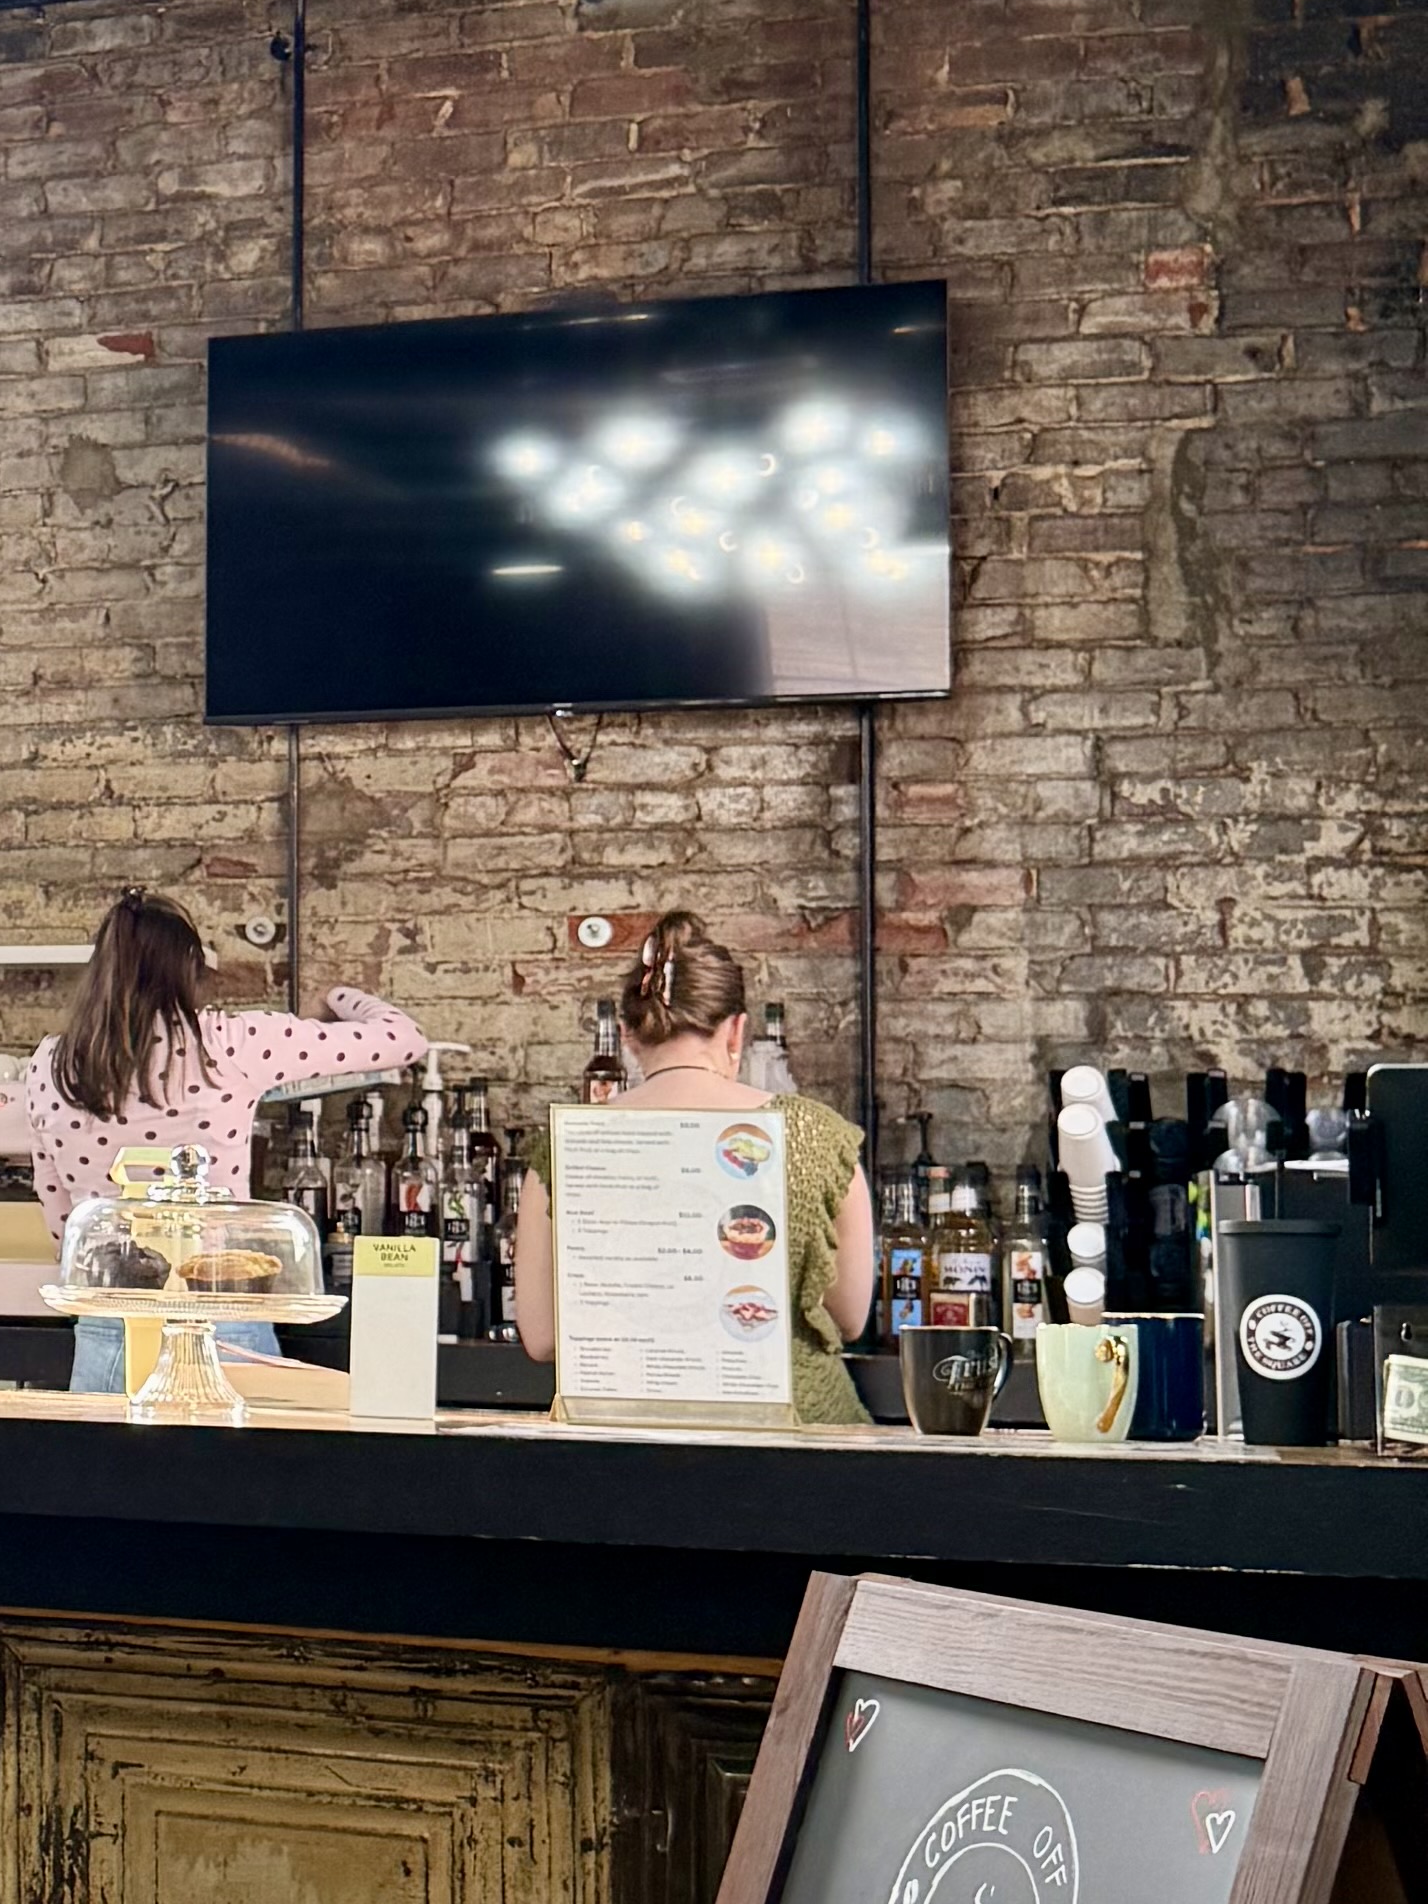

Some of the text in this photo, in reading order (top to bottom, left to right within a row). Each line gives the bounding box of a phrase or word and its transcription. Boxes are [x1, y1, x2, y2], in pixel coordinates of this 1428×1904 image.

[373, 1244, 416, 1252] VANILLA
[380, 1252, 409, 1261] BEAN
[924, 1795, 1068, 1887] COFFEE OFF
